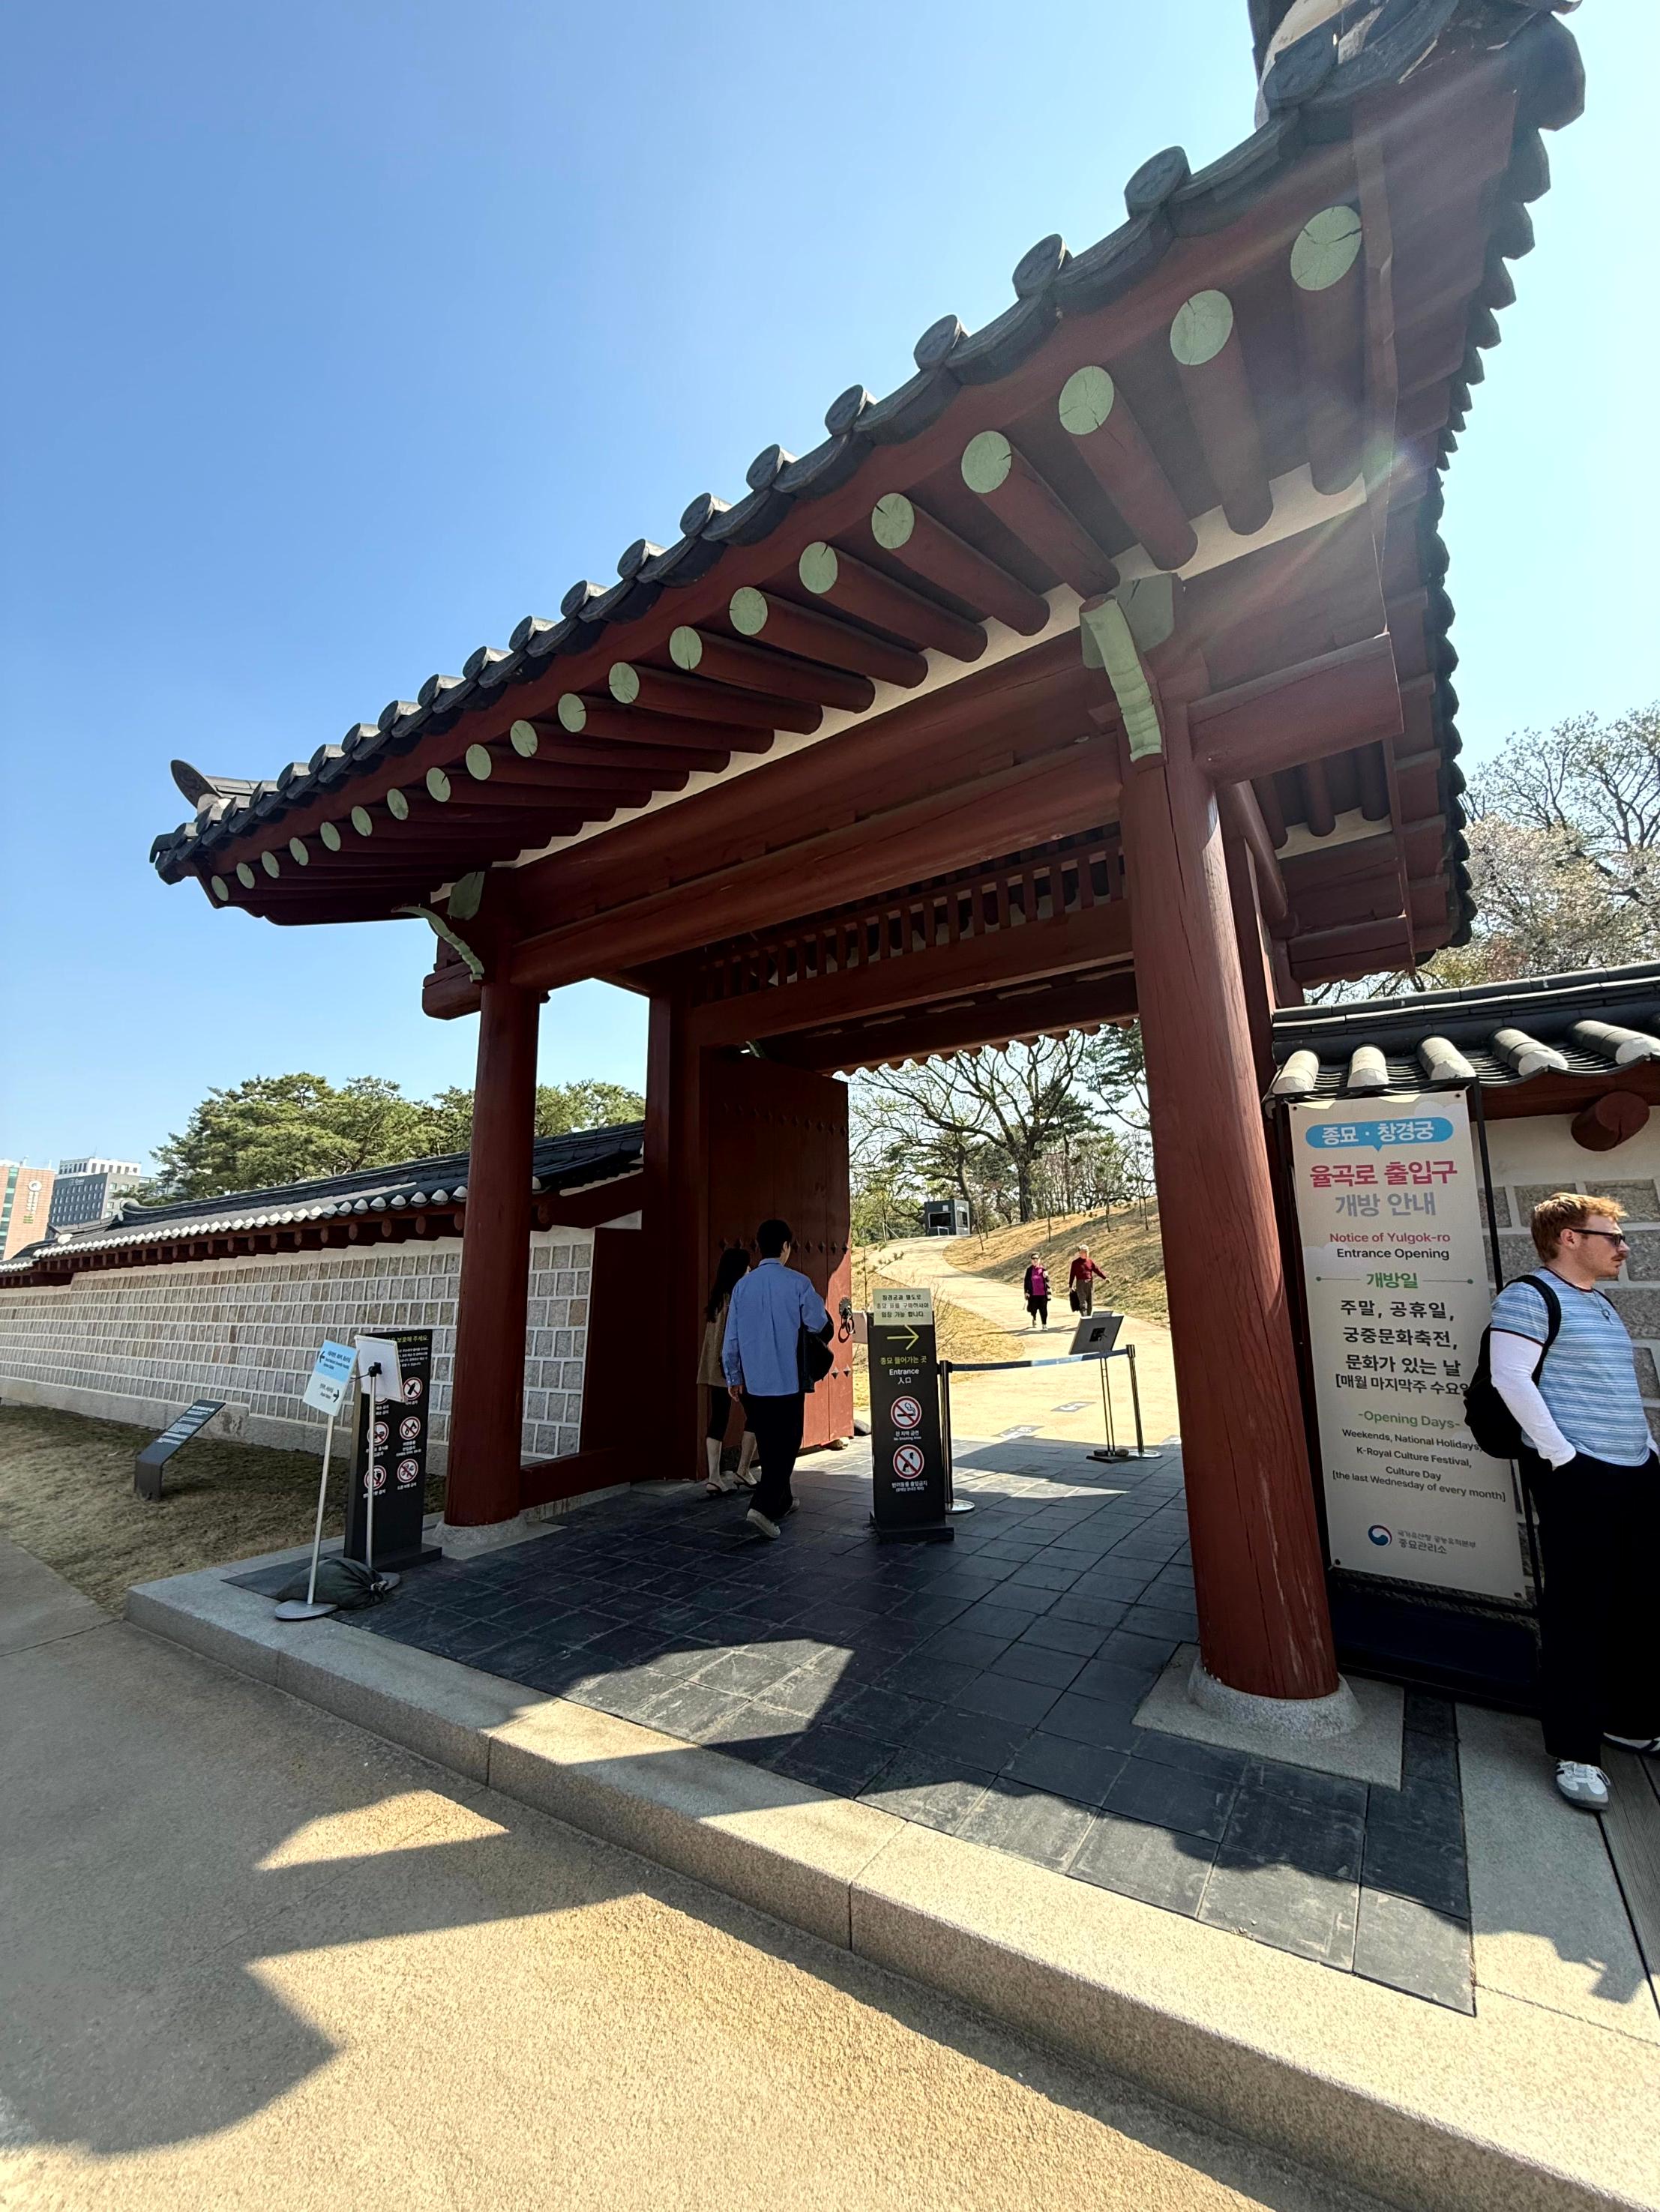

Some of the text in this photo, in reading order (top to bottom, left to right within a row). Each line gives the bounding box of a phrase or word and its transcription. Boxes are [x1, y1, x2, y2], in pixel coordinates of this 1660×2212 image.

[1322, 1127, 1359, 1145] 종묘
[1377, 1121, 1434, 1142] 창경궁
[1310, 1160, 1458, 1188] 율곡로 출입구
[1335, 1192, 1436, 1217] 개방 안내
[1329, 1232, 1451, 1244] Notice of Yulgok-ro
[1337, 1248, 1449, 1261] Entrance Opening
[1367, 1272, 1419, 1289] 개방일
[1341, 1300, 1454, 1322] 주말, 공휴일,
[1343, 1327, 1457, 1350] 궁중문화축전,
[880, 1357, 893, 1365] 종묘
[1346, 1354, 1461, 1377] 문화가 있는 날
[1335, 1373, 1368, 1389] [매월
[1371, 1376, 1427, 1393] 마지막주
[1342, 1429, 1482, 1452] Weekends, National Holidays,
[1356, 1447, 1472, 1468] K-Royal Culture Festival,
[1386, 1466, 1441, 1481] Culture Day
[1332, 1470, 1506, 1503] [the last Wednesday of every month]
[1398, 1537, 1447, 1554] 종묘관리소
